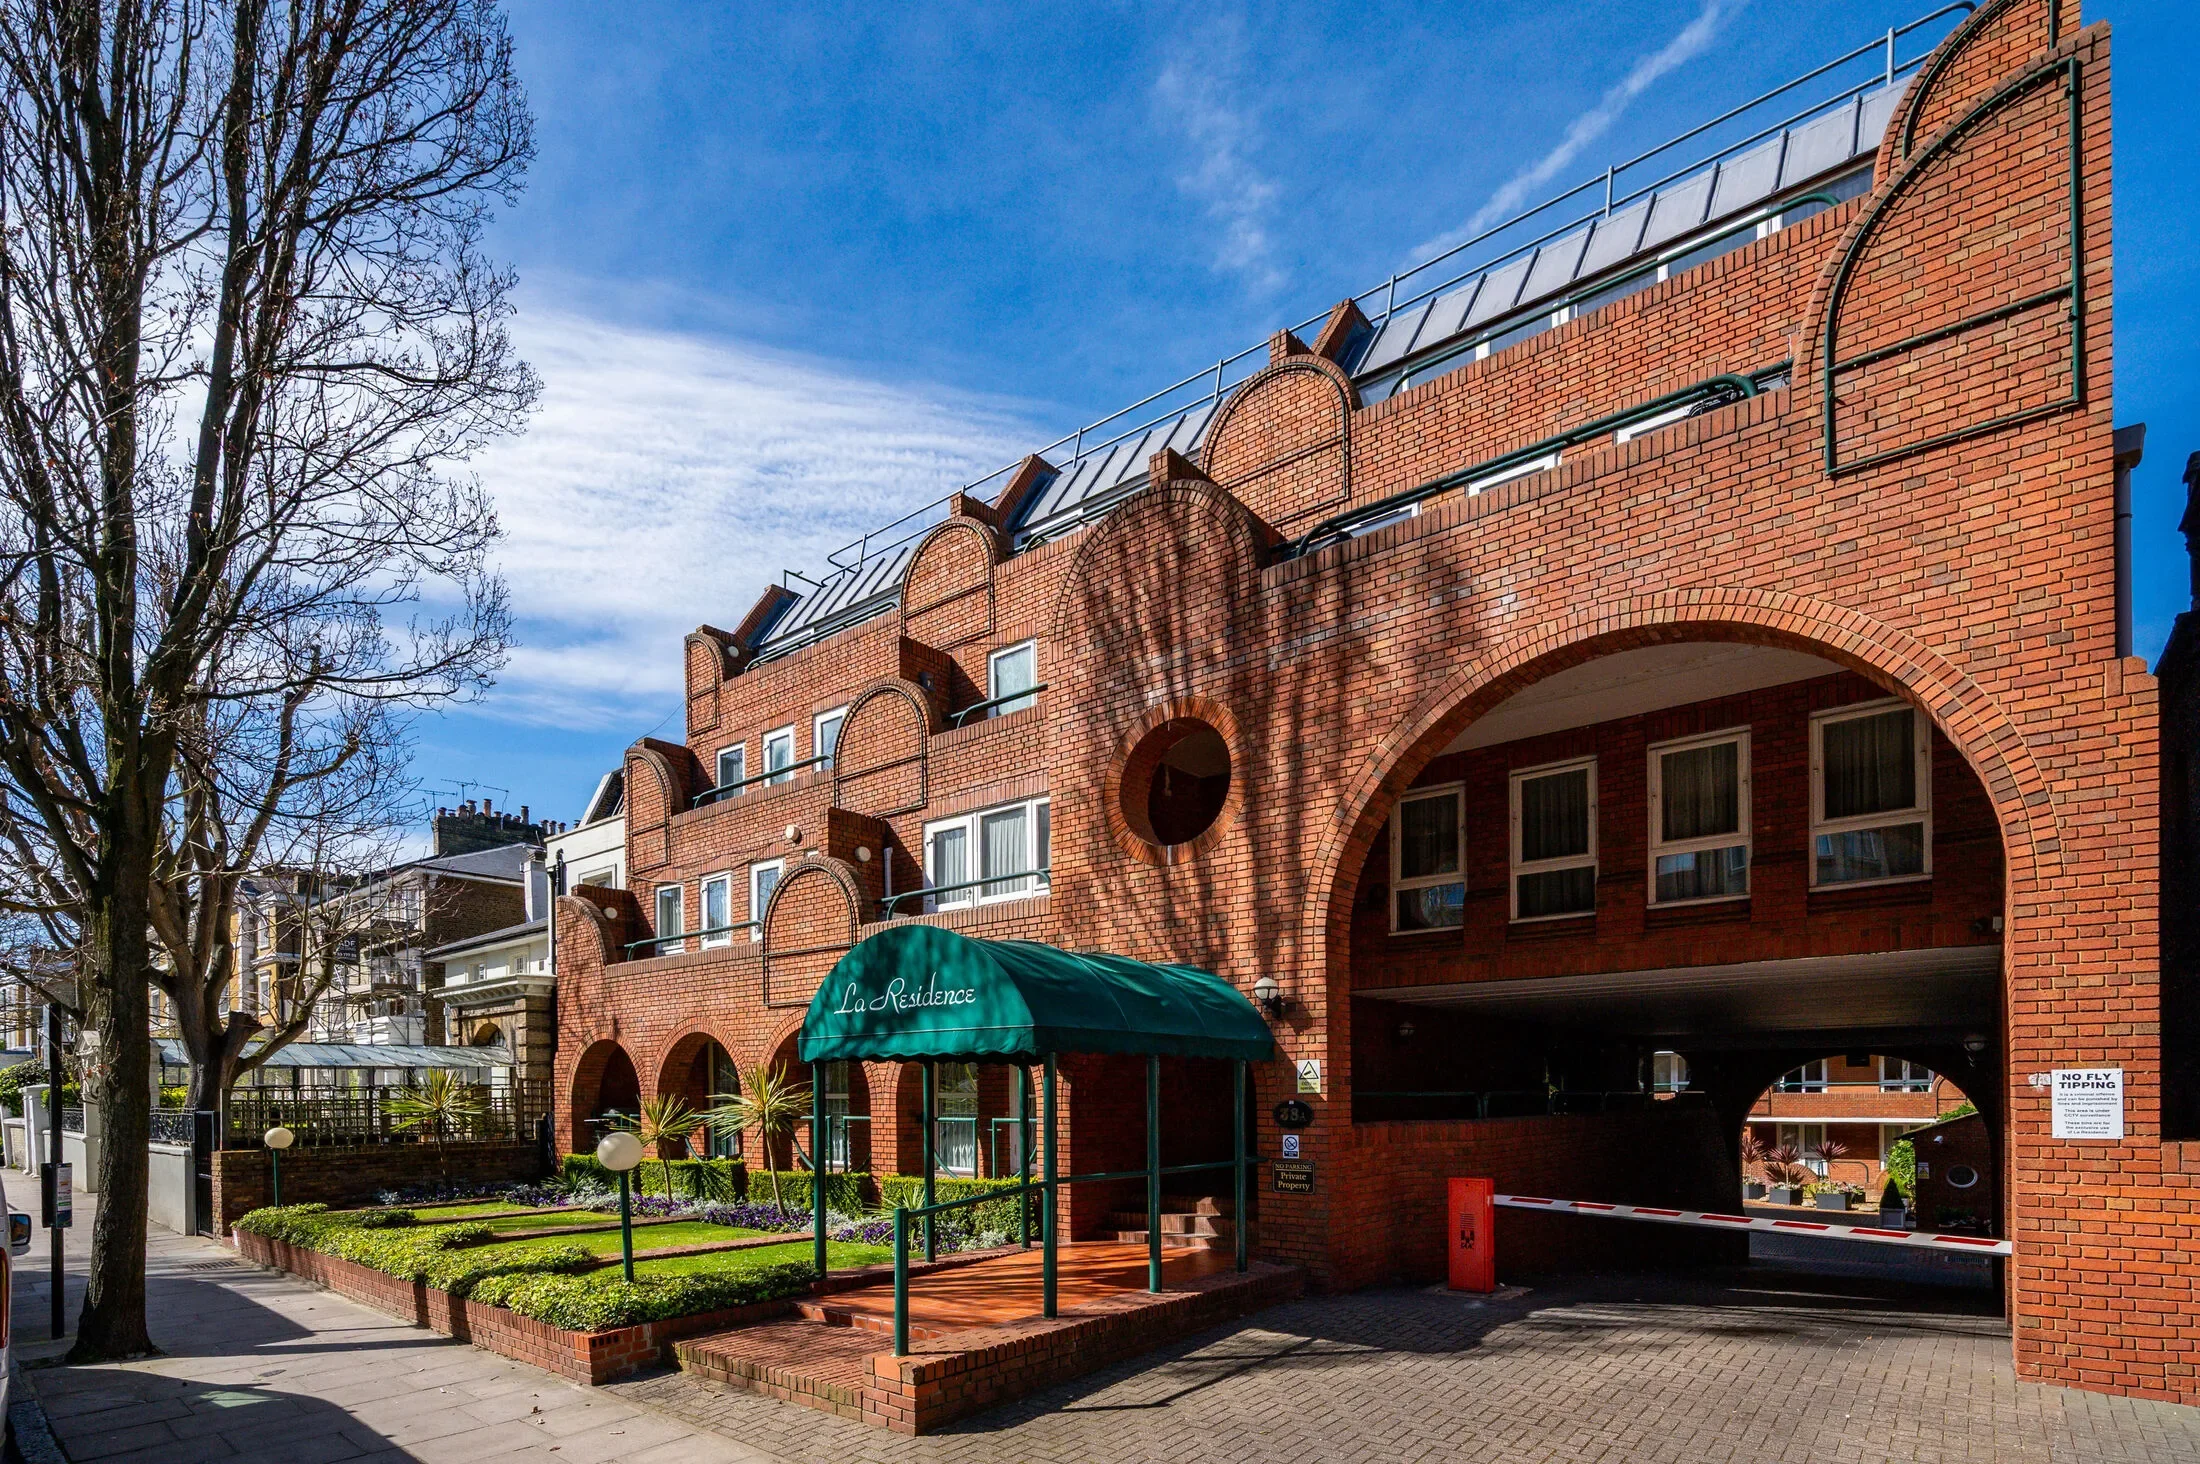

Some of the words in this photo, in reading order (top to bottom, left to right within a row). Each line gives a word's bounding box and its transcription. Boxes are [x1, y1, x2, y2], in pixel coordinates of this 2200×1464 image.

[834, 982, 867, 1014] La
[869, 971, 976, 1014] Residence
[1280, 1172, 1307, 1180] Private
[1278, 1181, 1310, 1191] Property
